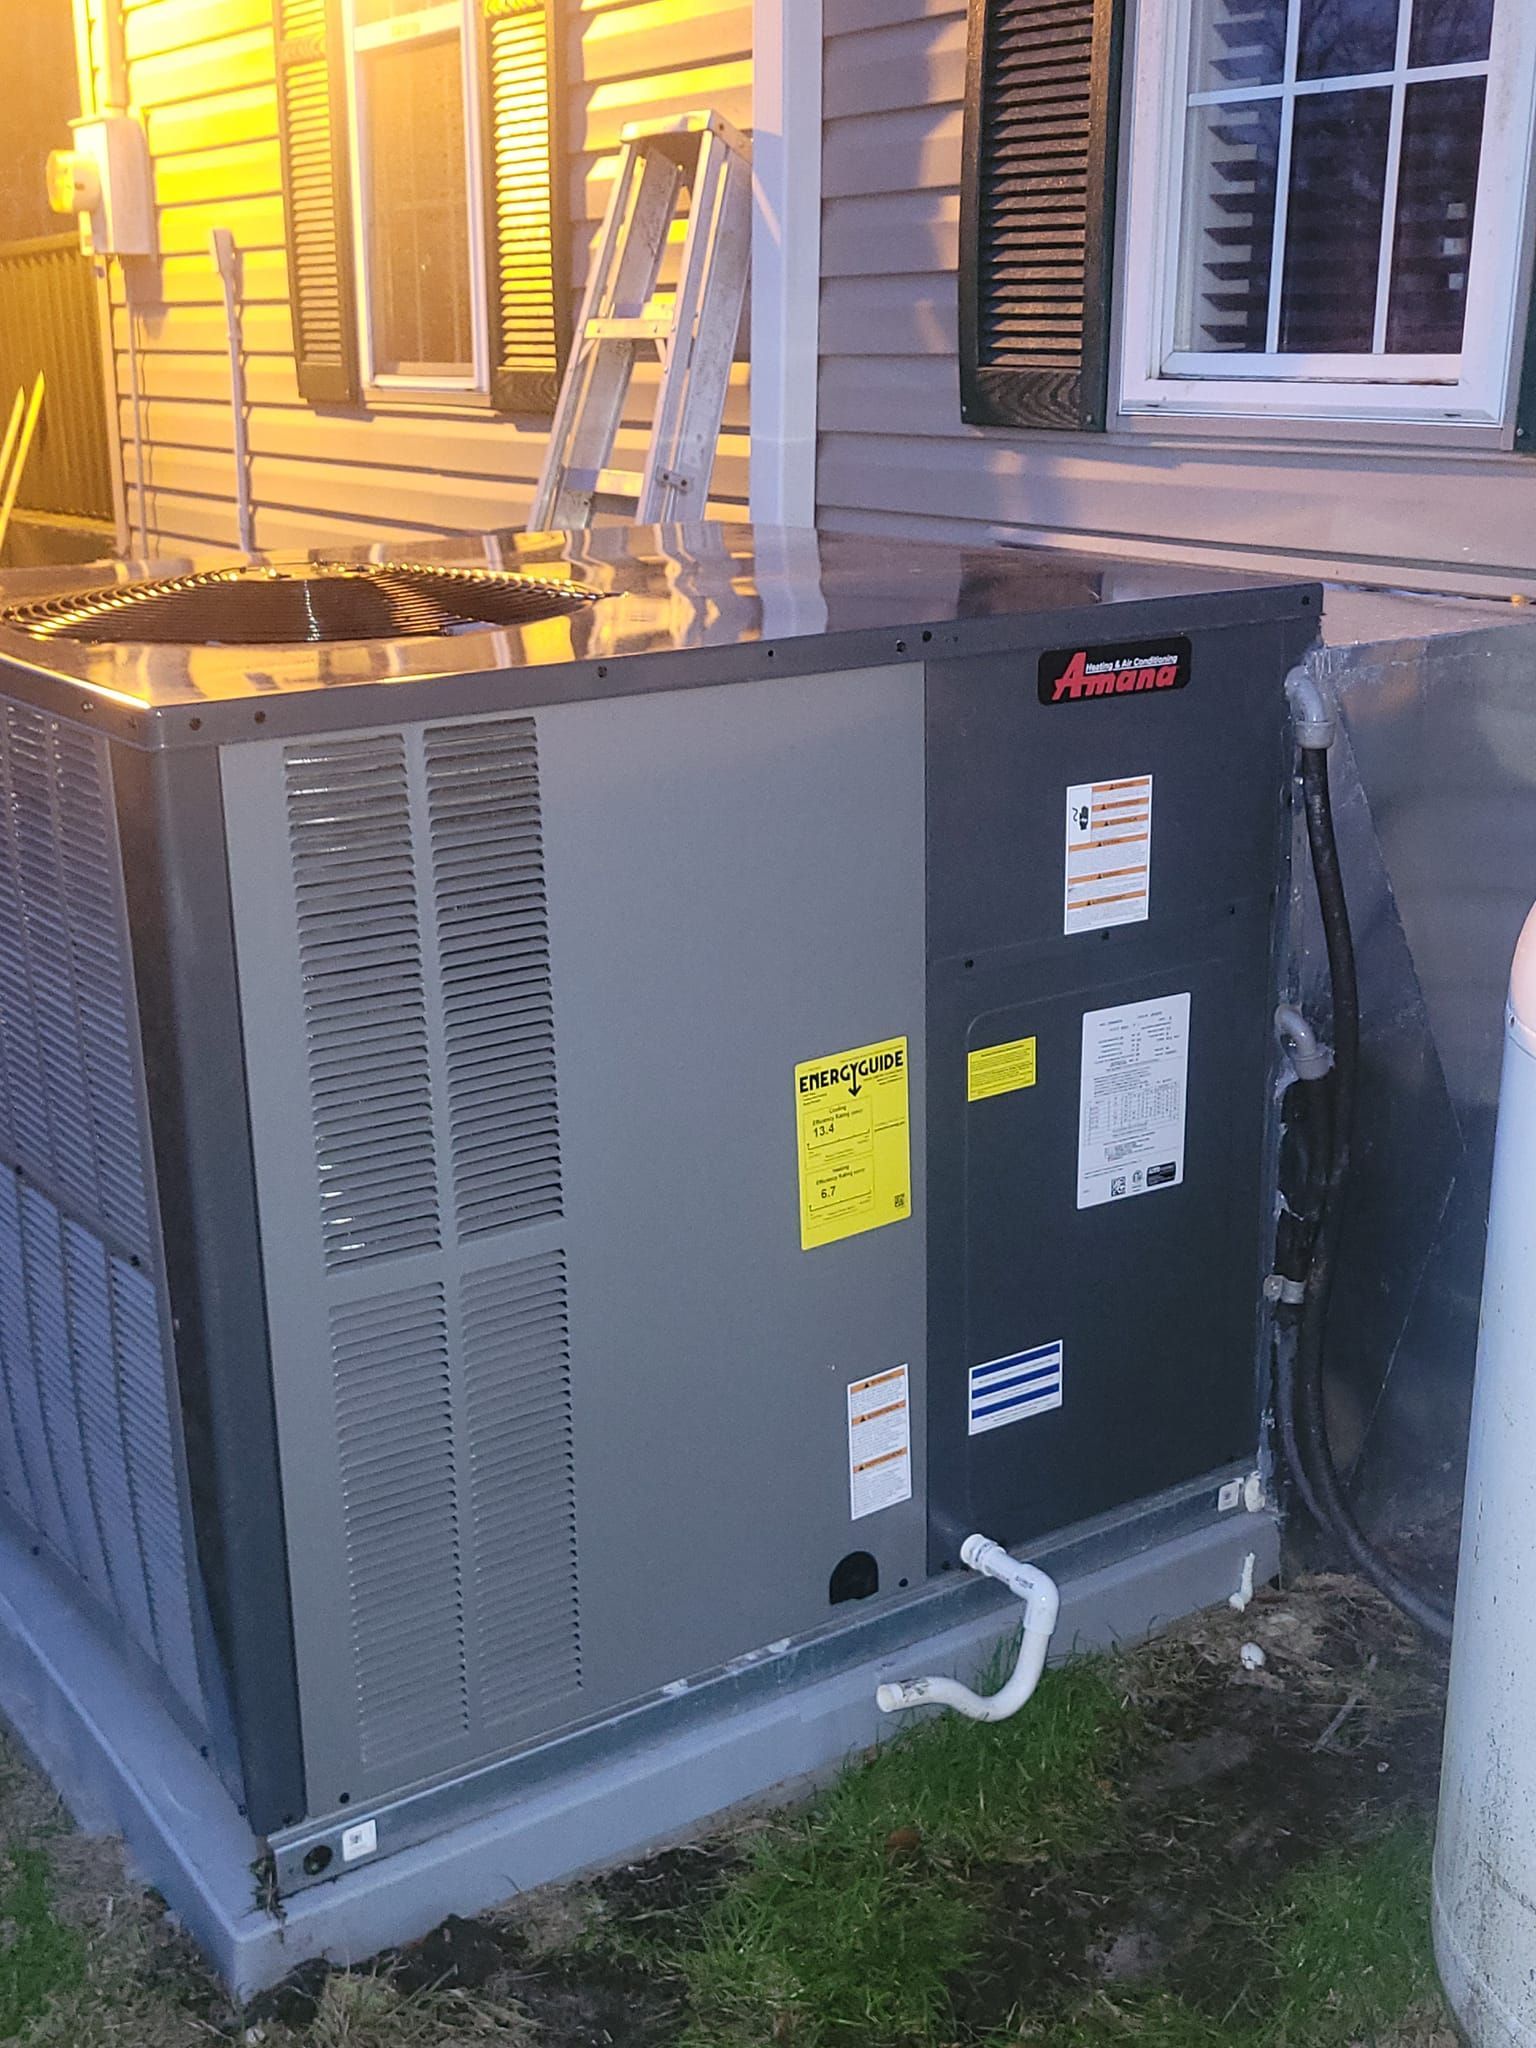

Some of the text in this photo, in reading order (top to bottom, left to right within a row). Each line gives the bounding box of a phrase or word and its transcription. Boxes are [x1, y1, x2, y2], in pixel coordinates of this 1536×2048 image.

[1086, 654, 1178, 673] Heating & Air Conditioning
[1052, 651, 1178, 701] Amana
[799, 1050, 903, 1095] ENERGYGUIDE
[813, 1122, 834, 1138] 13.4
[820, 1185, 836, 1199] 6.7
